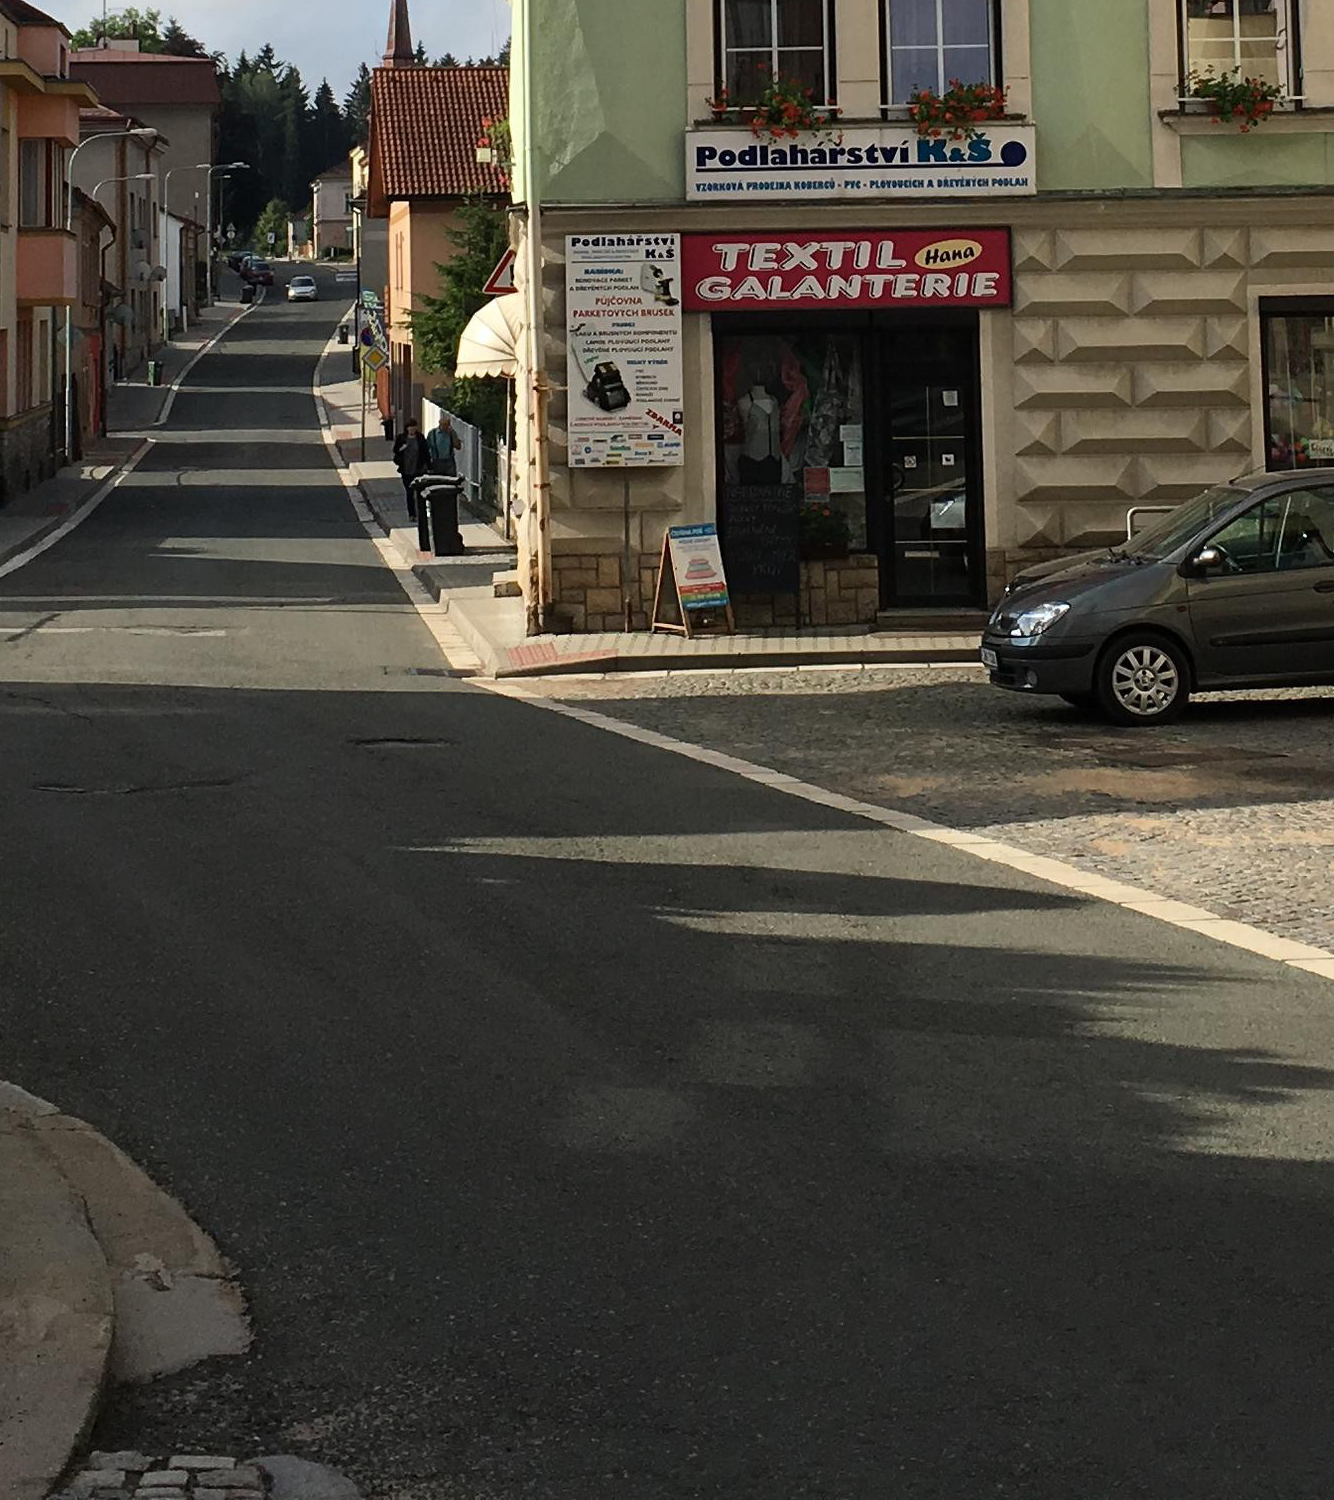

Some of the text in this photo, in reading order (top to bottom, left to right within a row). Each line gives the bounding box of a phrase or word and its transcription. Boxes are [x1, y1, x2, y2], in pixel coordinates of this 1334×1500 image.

[696, 133, 992, 167] Podlahářství K&Š
[696, 180, 743, 192] VZORKOVÁ
[746, 181, 792, 191] PRODEJNA
[927, 179, 934, 188] A
[992, 177, 1028, 187] PODLAH
[571, 235, 675, 247] Podlahářství
[712, 241, 975, 272] TEXTIL Hana
[695, 272, 1000, 301] GALANTERIE
[640, 308, 675, 317] BRUSEK
